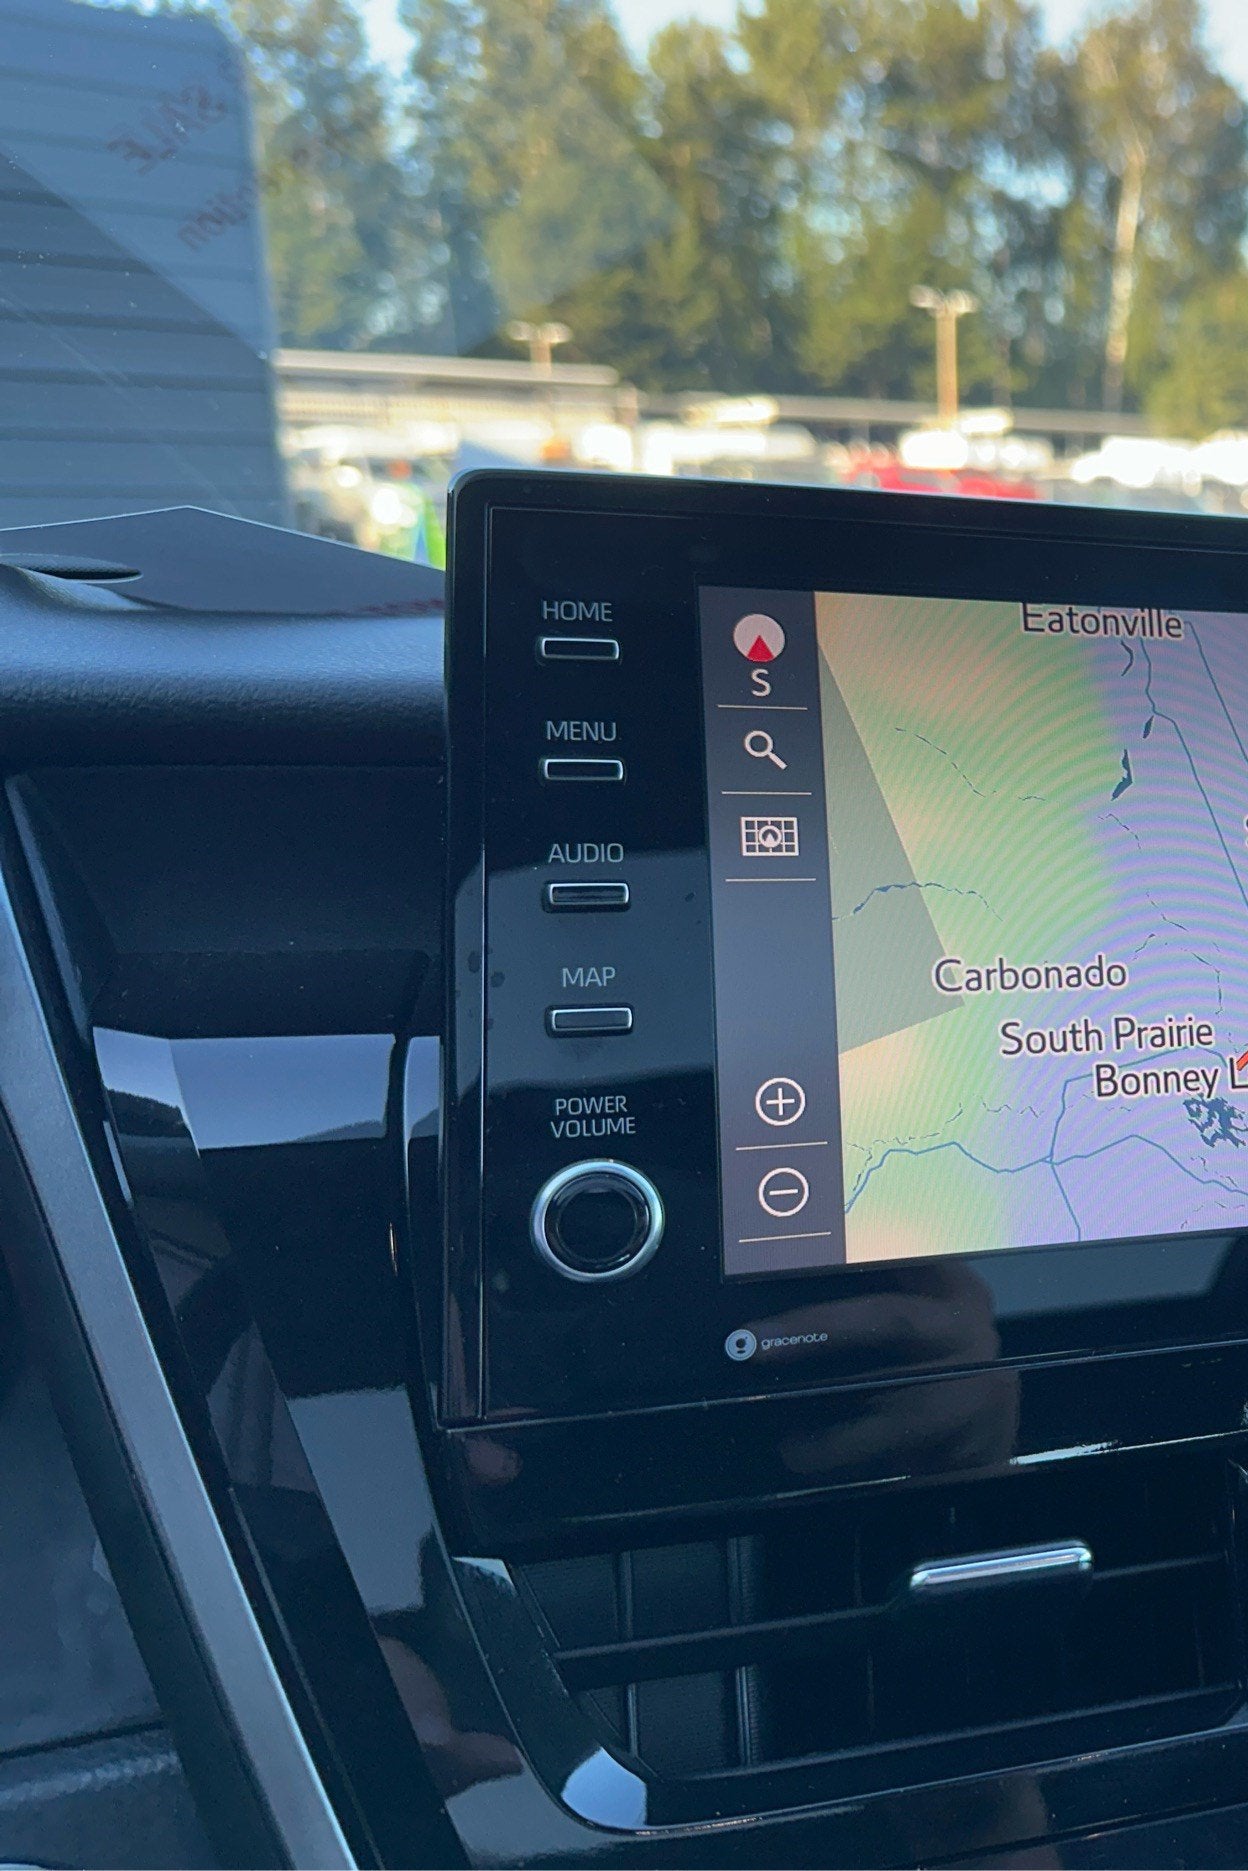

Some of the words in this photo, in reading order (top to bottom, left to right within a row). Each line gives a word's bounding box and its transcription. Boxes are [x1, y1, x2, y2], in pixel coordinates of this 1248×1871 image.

[542, 600, 613, 622] HOME
[1022, 602, 1183, 638] Eatonville
[751, 668, 772, 698] S
[545, 720, 618, 742] MENU
[548, 843, 625, 864] AUDIO
[561, 966, 616, 988] MAP
[934, 954, 1127, 993] Carbonado
[1000, 1020, 1104, 1055] South
[1114, 1017, 1213, 1050] Prairie
[1094, 1064, 1219, 1098] Bonney
[555, 1095, 628, 1115] POWER
[550, 1117, 637, 1139] VOLUME
[761, 1333, 828, 1351] gracenote
